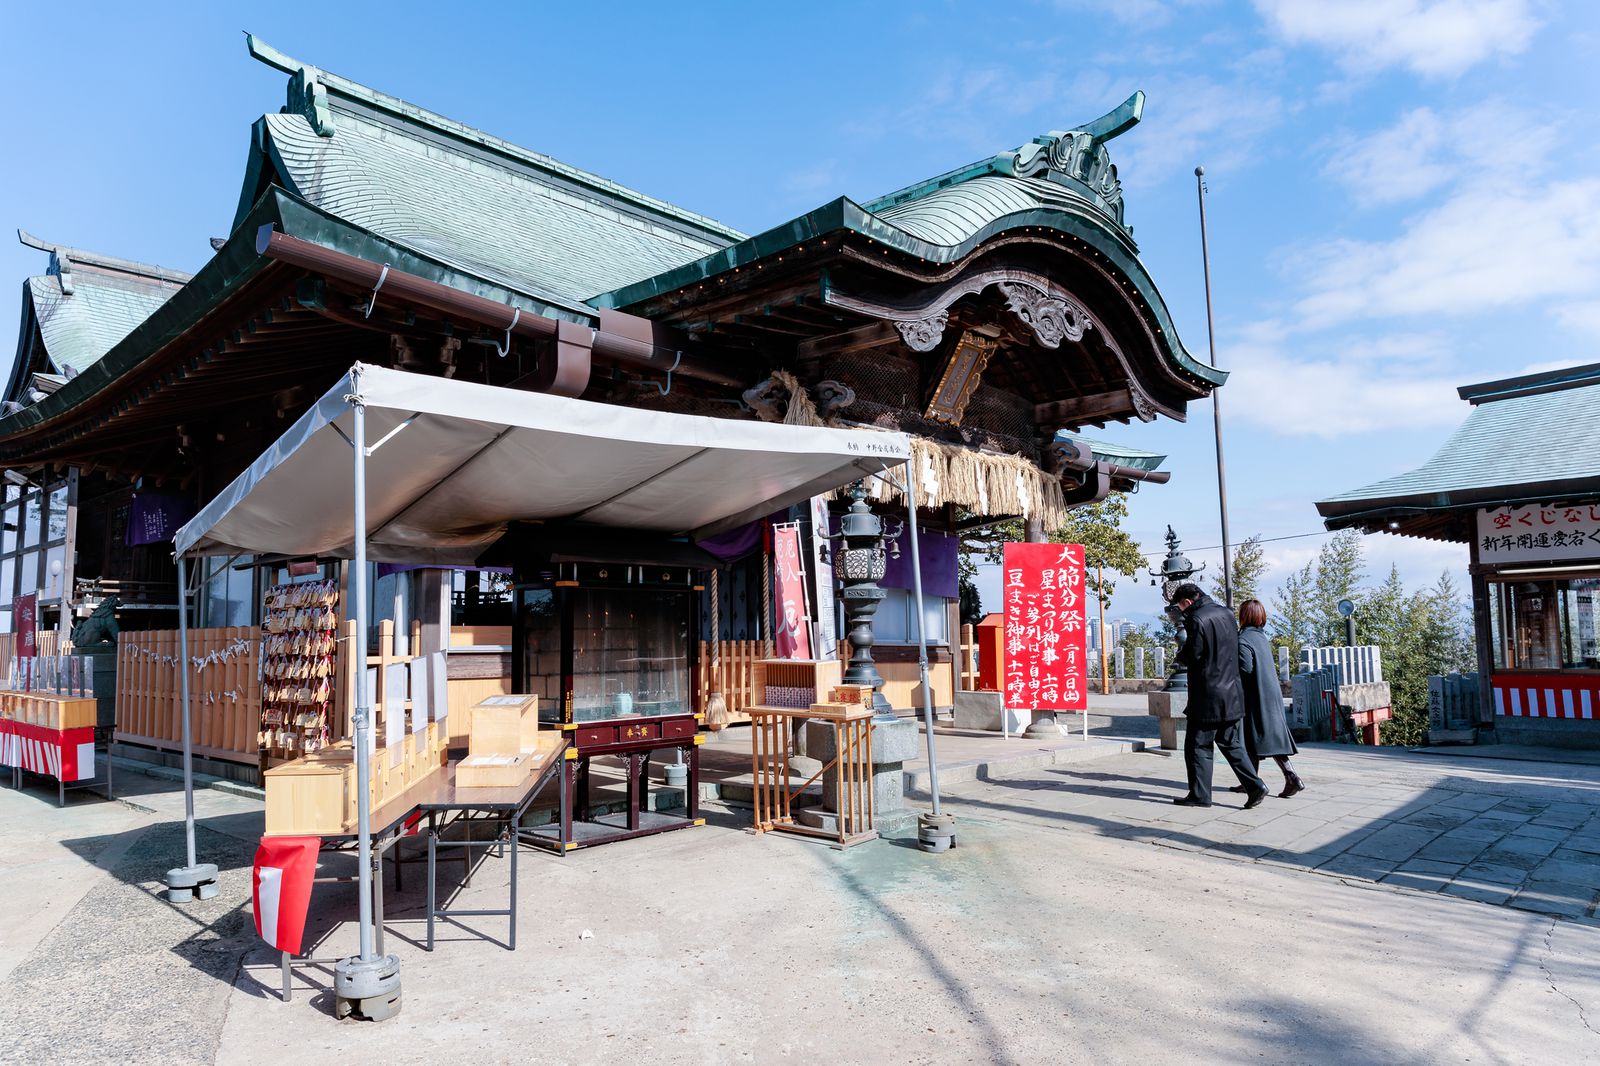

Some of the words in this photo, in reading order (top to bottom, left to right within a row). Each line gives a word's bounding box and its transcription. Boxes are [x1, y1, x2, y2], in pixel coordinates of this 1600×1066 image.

[1493, 506, 1600, 529] 空くじなし
[1006, 568, 1026, 656] 豆まき神事
[1039, 569, 1060, 666] 星まつり神事
[1056, 546, 1083, 632] 大節分祭
[1007, 660, 1025, 707] 十一時半
[1025, 593, 1041, 710] ご参列はご自由です
[1042, 673, 1059, 703] 十一時
[1063, 643, 1080, 703] 二月三日(土)
